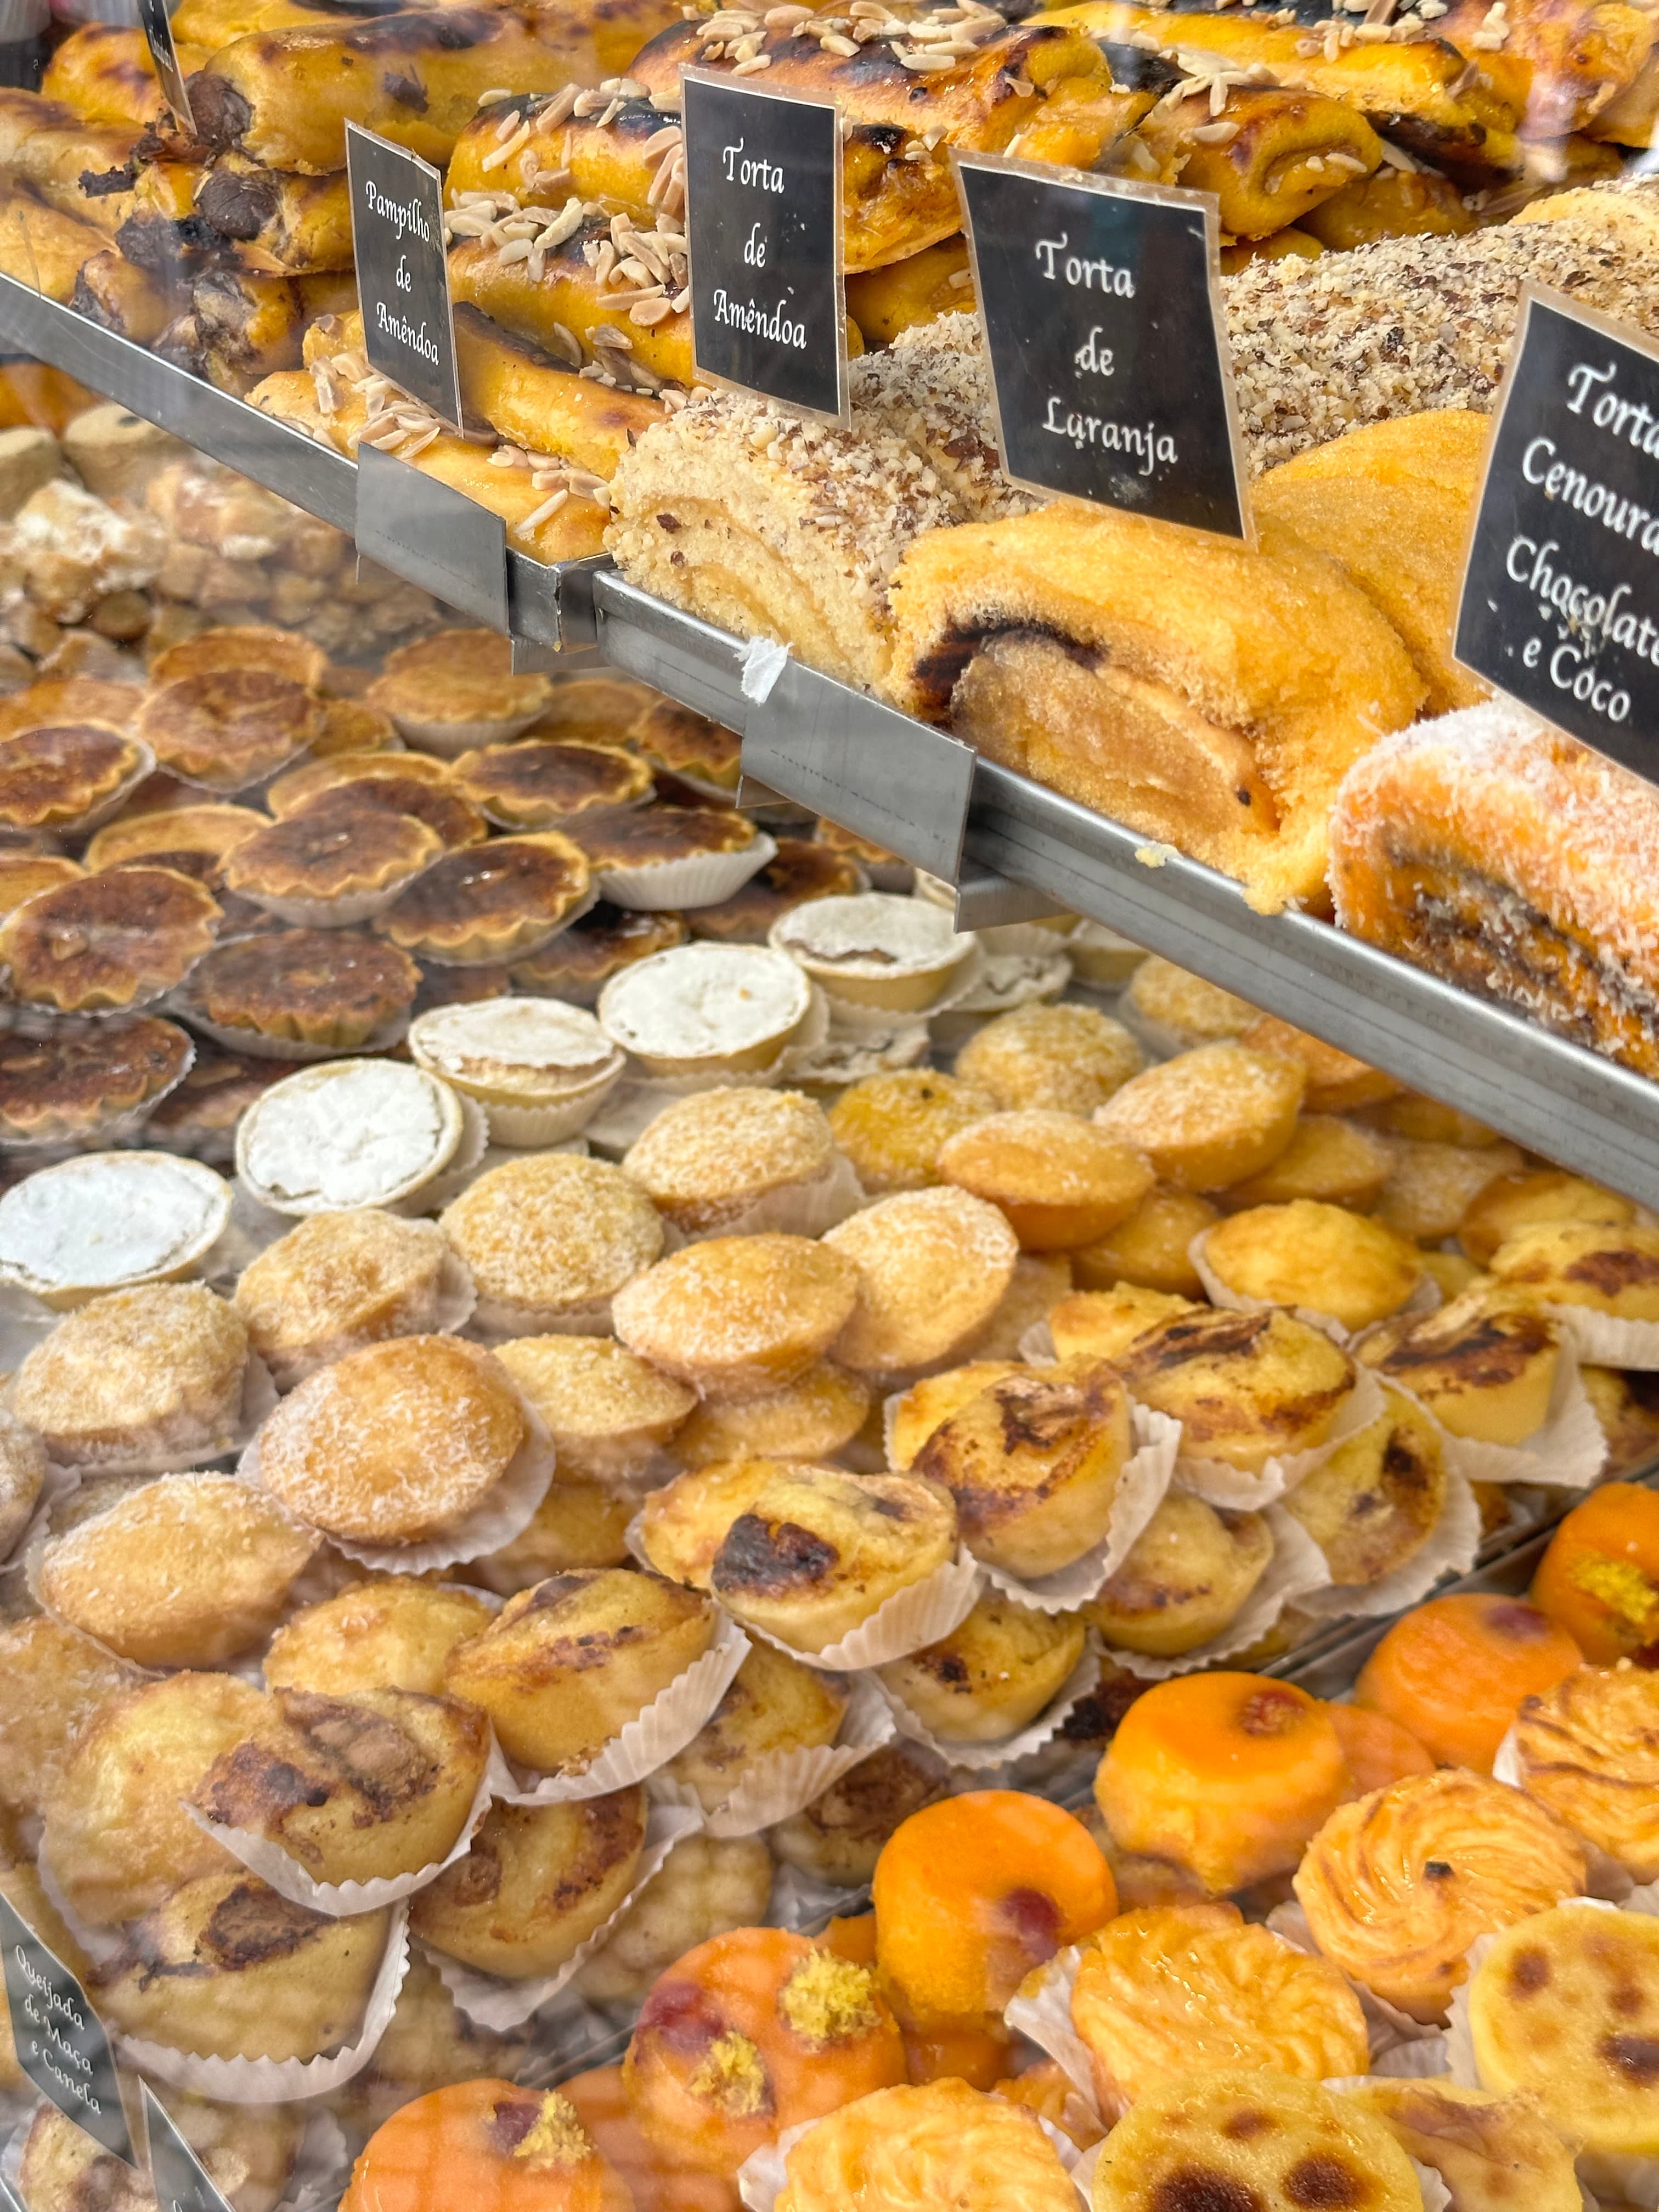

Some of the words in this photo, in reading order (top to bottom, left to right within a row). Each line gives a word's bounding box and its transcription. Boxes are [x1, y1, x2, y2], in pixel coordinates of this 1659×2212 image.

[723, 138, 785, 194] Torta
[366, 180, 430, 242] Pampilho
[396, 255, 411, 292] de
[744, 223, 765, 268] de
[1036, 232, 1135, 298] Torta
[377, 303, 439, 365] Amêndoa
[714, 289, 806, 349] Amêndoa
[1076, 326, 1115, 376] de
[1042, 397, 1178, 476] Laranja
[1567, 362, 1659, 460] Torta
[1522, 438, 1659, 556] Cenoura
[1523, 638, 1542, 668] e
[1550, 645, 1630, 722] Coco
[16, 1945, 84, 2030] Queijada
[25, 1994, 40, 2023] de
[32, 2040, 38, 2055] e
[43, 2049, 101, 2114] Canela
